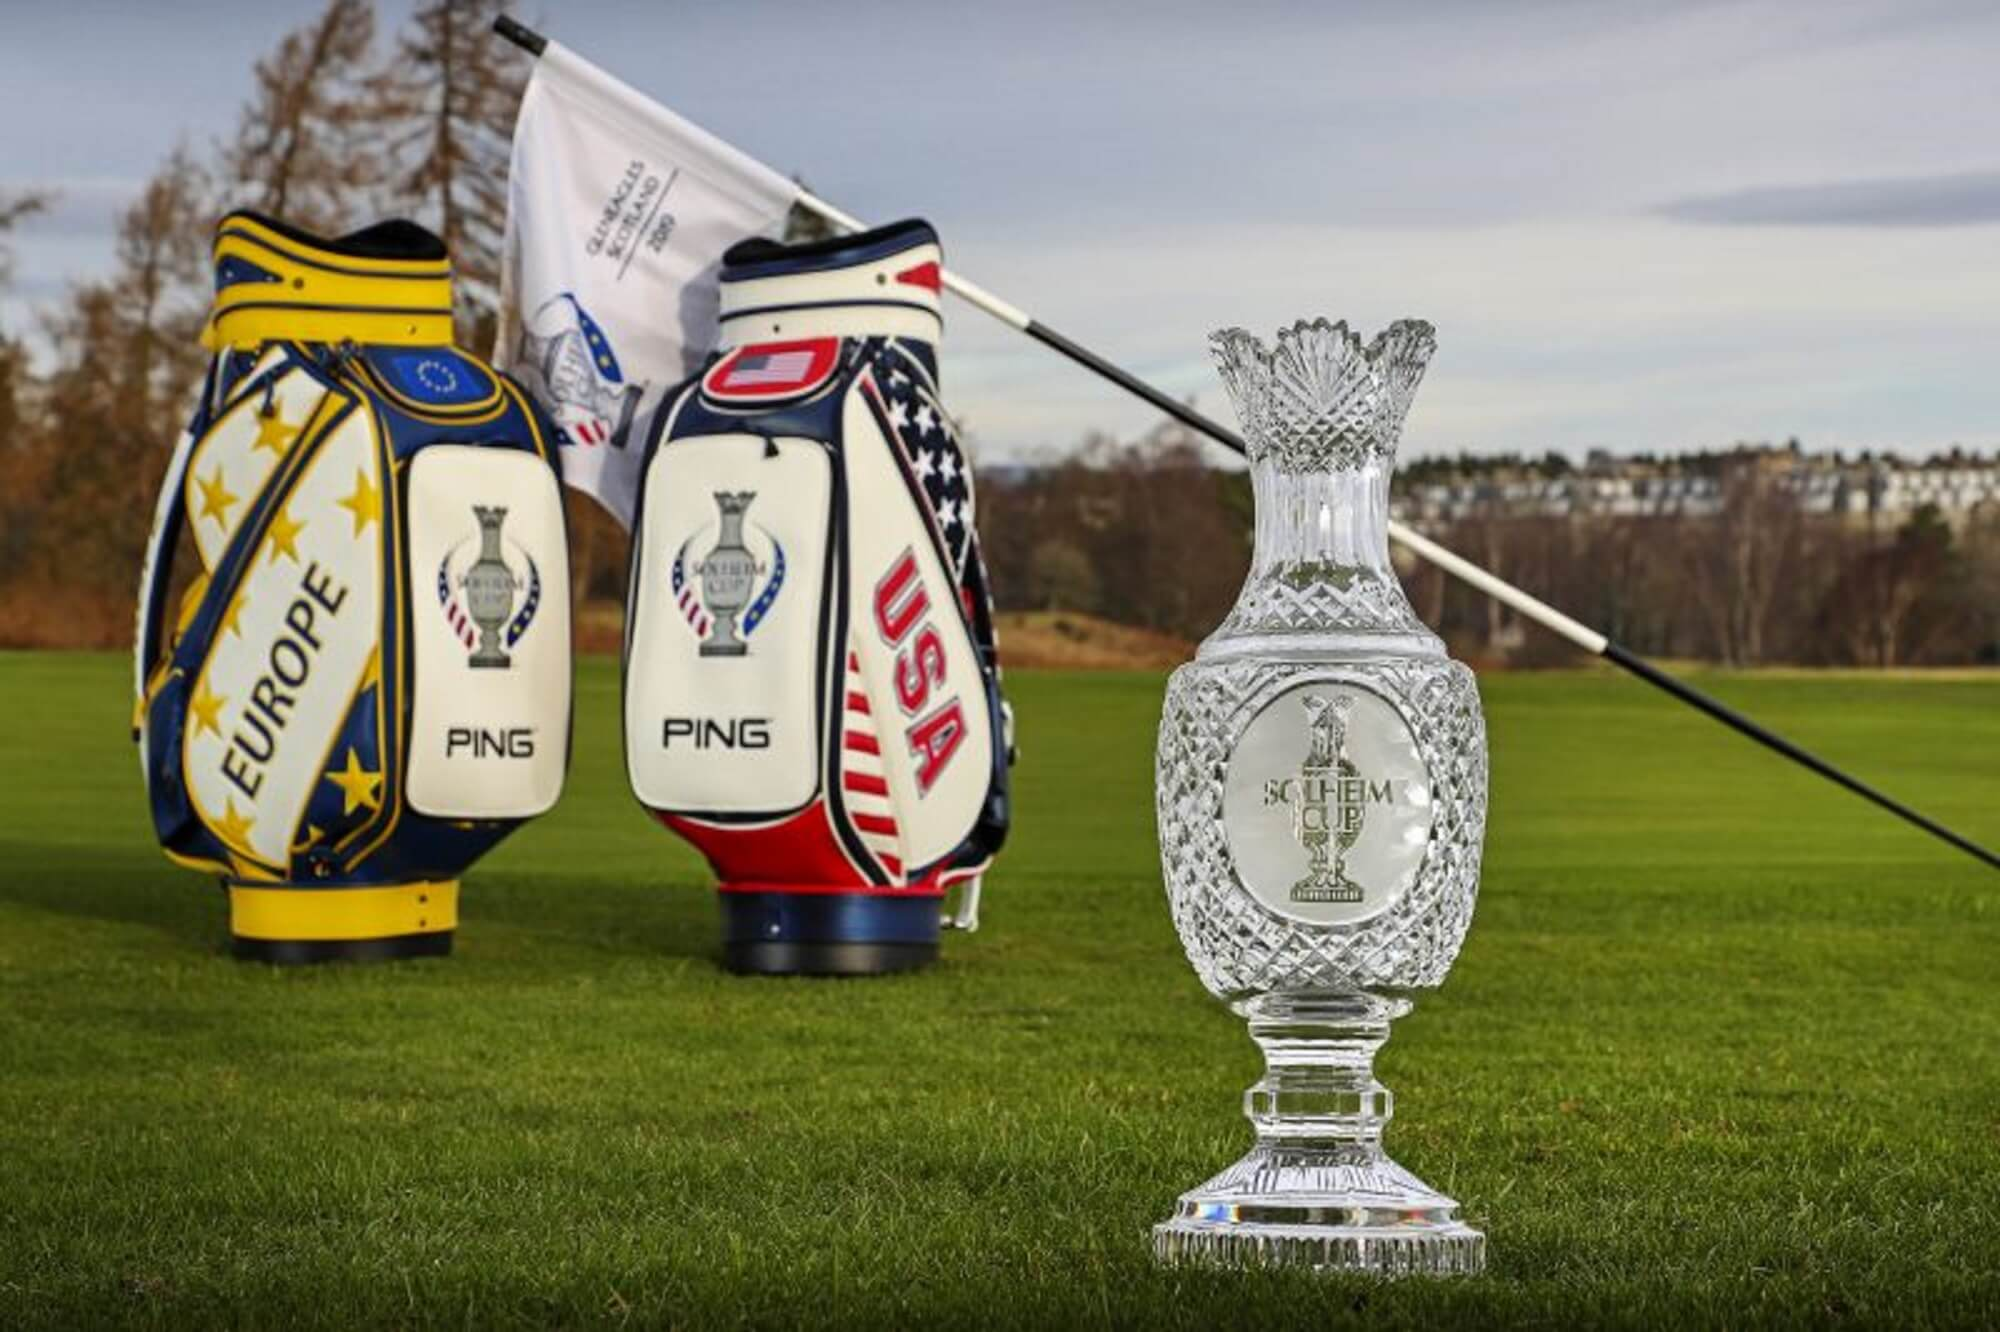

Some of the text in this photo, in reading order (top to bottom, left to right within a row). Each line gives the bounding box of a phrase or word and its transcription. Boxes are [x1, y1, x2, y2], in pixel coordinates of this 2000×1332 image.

[585, 160, 645, 256] GLENEAGLES
[606, 175, 660, 260] SCOTLAND
[646, 213, 676, 254] 2019
[220, 560, 348, 800] EUROPE
[873, 544, 968, 800] USA
[445, 727, 536, 760] PING
[662, 717, 771, 750] PING
[1263, 778, 1394, 806] SOLHEIM
[1301, 805, 1362, 832] CUP
